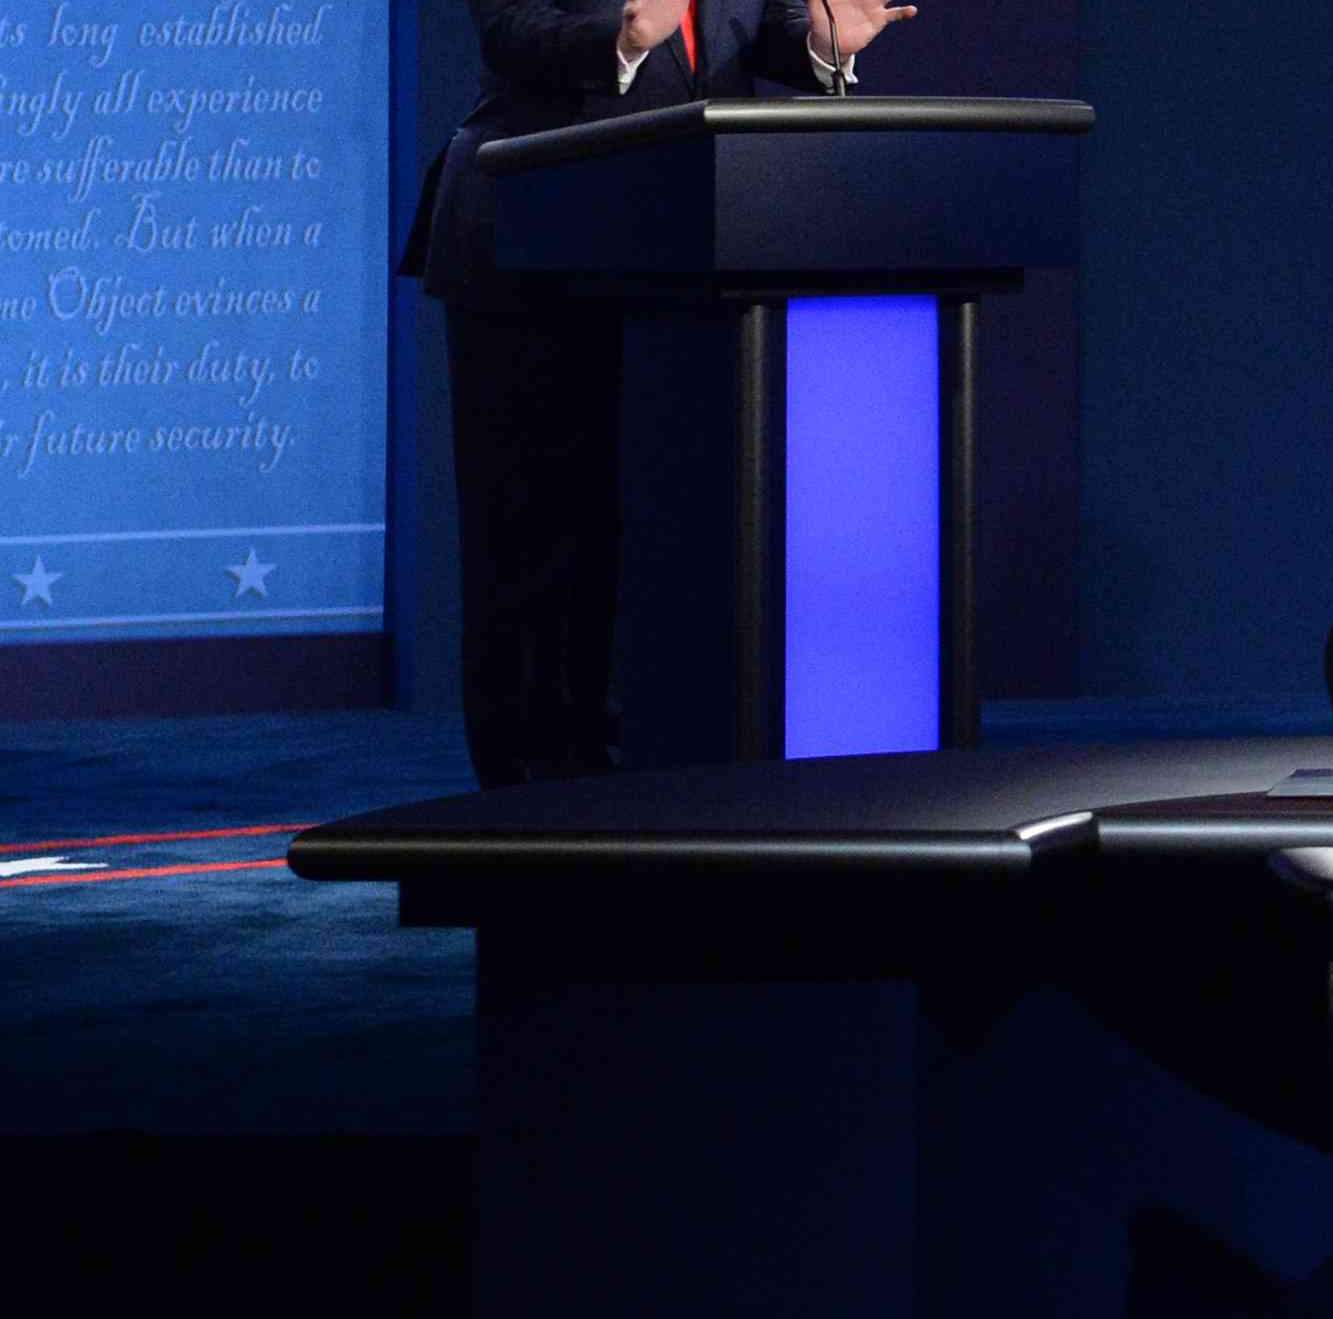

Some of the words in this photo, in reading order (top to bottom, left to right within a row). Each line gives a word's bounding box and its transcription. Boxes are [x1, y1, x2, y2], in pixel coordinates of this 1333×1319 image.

[49, 2, 119, 68] long
[138, 1, 333, 47] established
[94, 69, 145, 114] all
[147, 75, 323, 134] experience
[37, 135, 199, 203] sufferable
[207, 137, 281, 181] than
[289, 152, 321, 181] to
[113, 190, 198, 253] But
[210, 203, 293, 249] when
[303, 221, 323, 248] a
[48, 266, 167, 336] Object
[174, 277, 295, 317] evinces
[303, 288, 322, 315] a
[23, 351, 51, 389] it
[60, 347, 89, 389] is
[100, 343, 178, 387] their
[187, 340, 275, 410] duty,
[288, 347, 320, 382] to
[18, 409, 140, 479] future
[150, 412, 296, 473] security.
